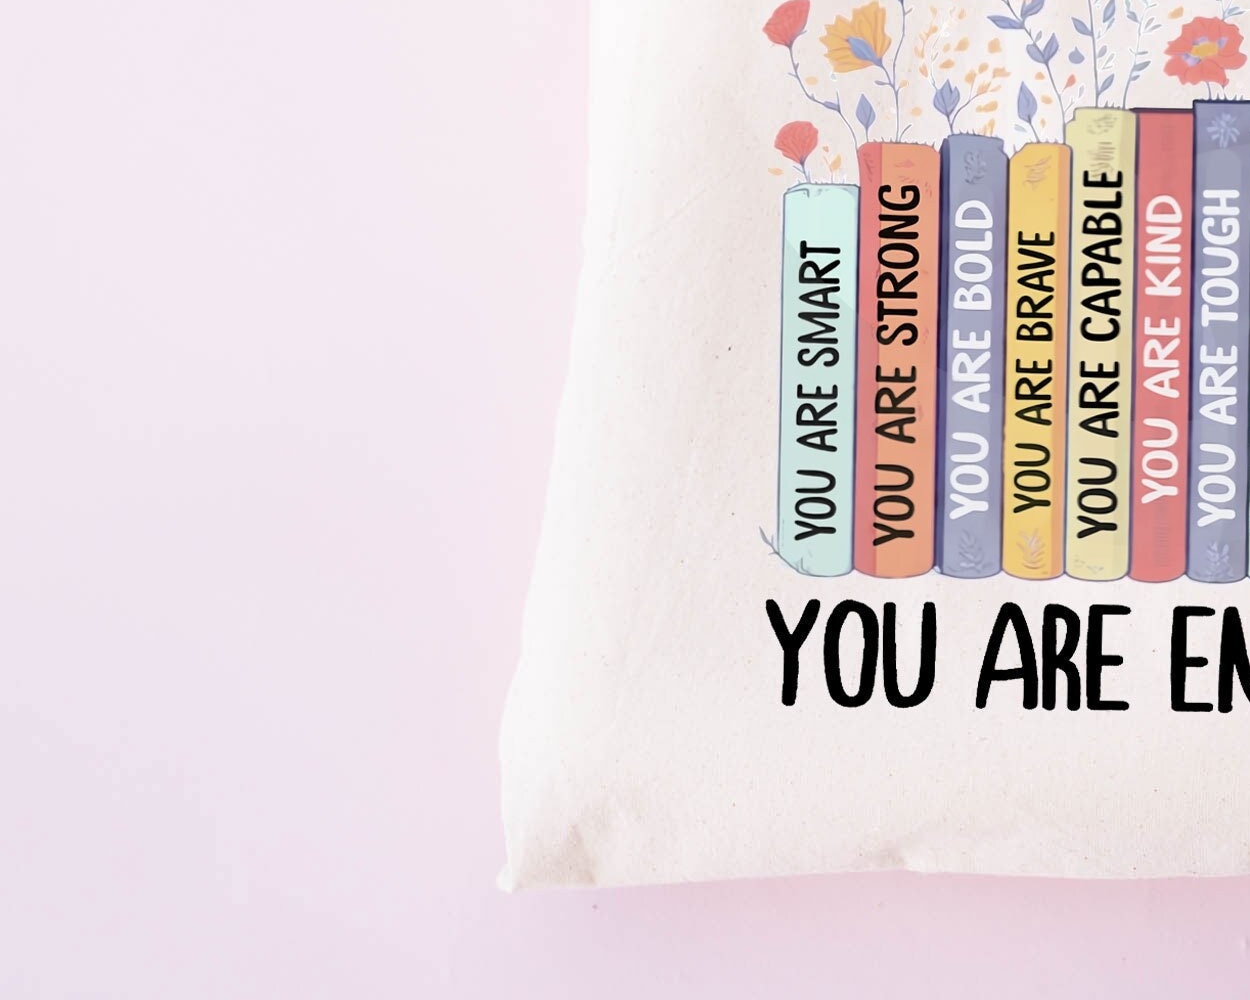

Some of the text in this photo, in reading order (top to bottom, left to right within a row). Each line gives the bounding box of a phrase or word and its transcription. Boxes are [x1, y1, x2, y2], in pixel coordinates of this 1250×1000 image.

[794, 240, 841, 541] YOU ARE SMART
[872, 184, 921, 547] YOU ARE STRONG
[949, 199, 994, 520] YOU ARE BOLD
[1013, 231, 1056, 514] YOU ARE BRAVE
[1077, 170, 1123, 539] YOU ARE CAPABLE
[1141, 194, 1184, 504] YOU ARE KIND
[1197, 188, 1240, 528] YOU ARE TOUGH
[765, 598, 936, 708] YOU
[975, 602, 1131, 711] ARE
